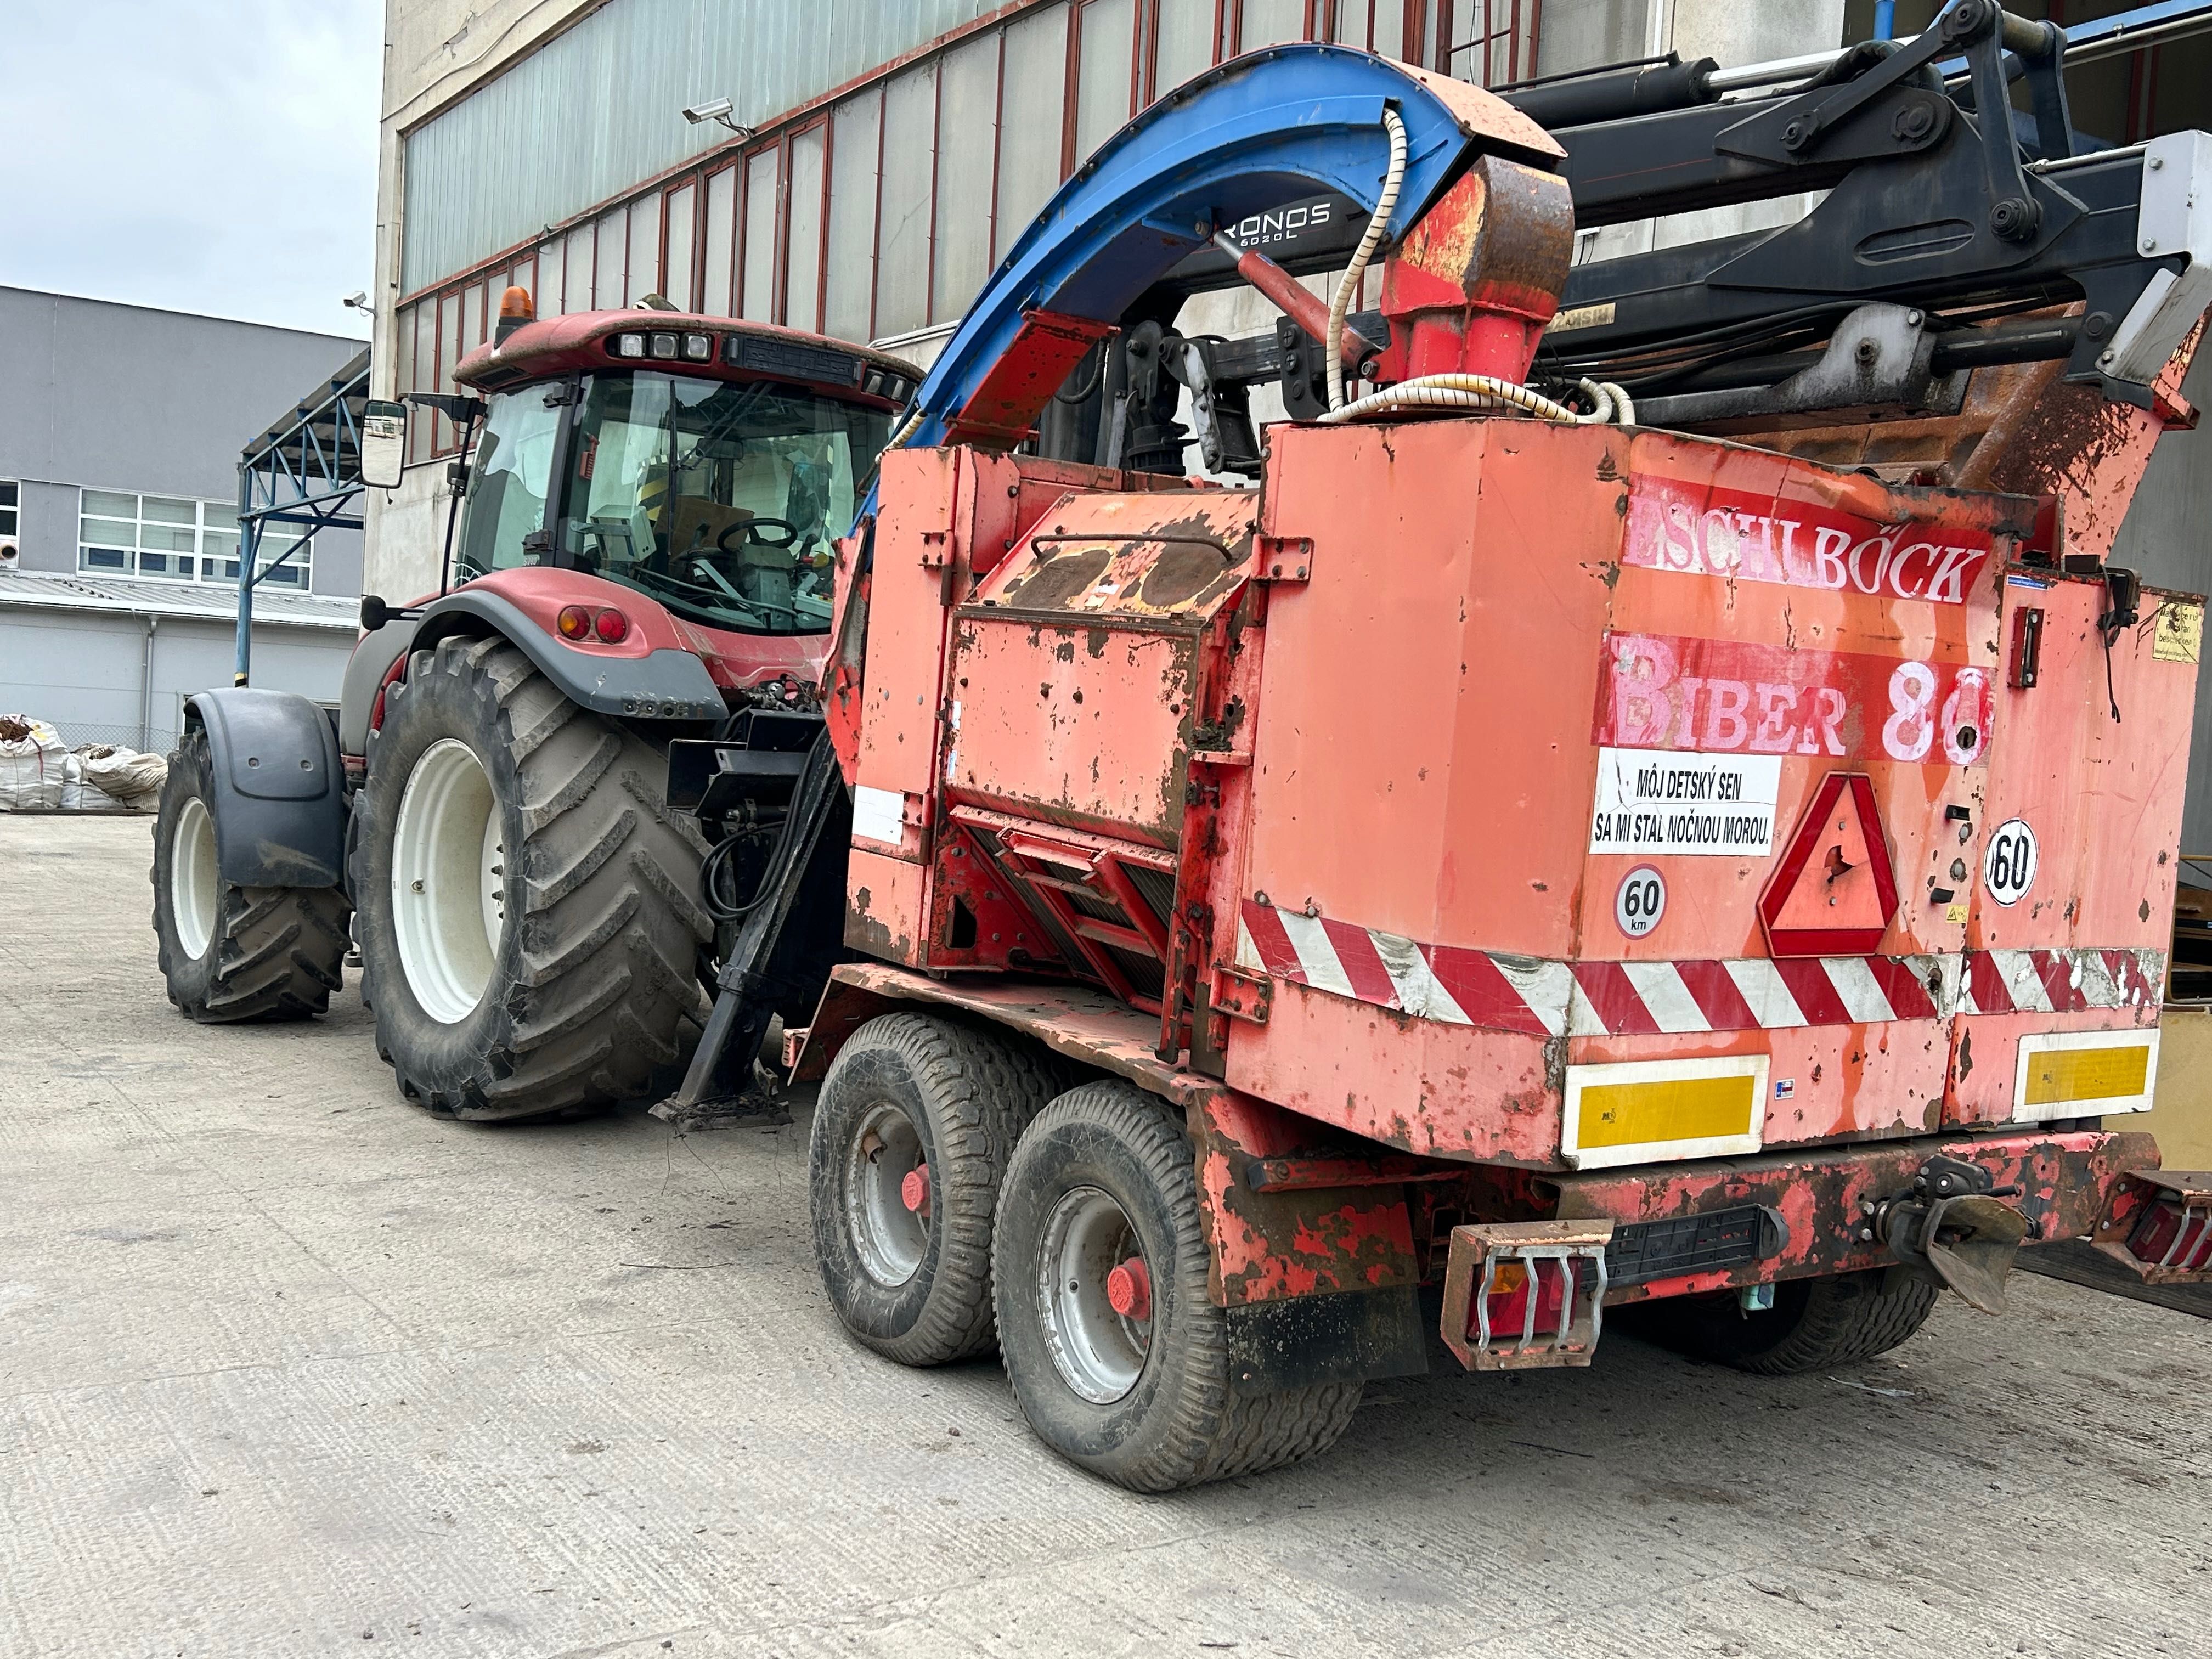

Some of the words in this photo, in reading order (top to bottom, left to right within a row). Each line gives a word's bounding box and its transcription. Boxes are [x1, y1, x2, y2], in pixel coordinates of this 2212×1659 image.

[1240, 229, 1297, 246] 6020L
[1624, 494, 1986, 604] ESCHLBÖCK
[1601, 635, 1847, 757] BIBER
[1637, 763, 1664, 798] MÔJ
[1666, 765, 1716, 799] DETSKÝ
[1718, 772, 1742, 800] SEN
[1595, 812, 1611, 842] SA
[1615, 814, 1632, 842] MI
[1634, 814, 1663, 842] STAL
[1667, 808, 1721, 843] NOČNOU
[1723, 816, 1769, 844] MOROU.
[1994, 834, 2029, 890] 60
[1624, 880, 1660, 917] 60
[1631, 919, 1646, 930] km
